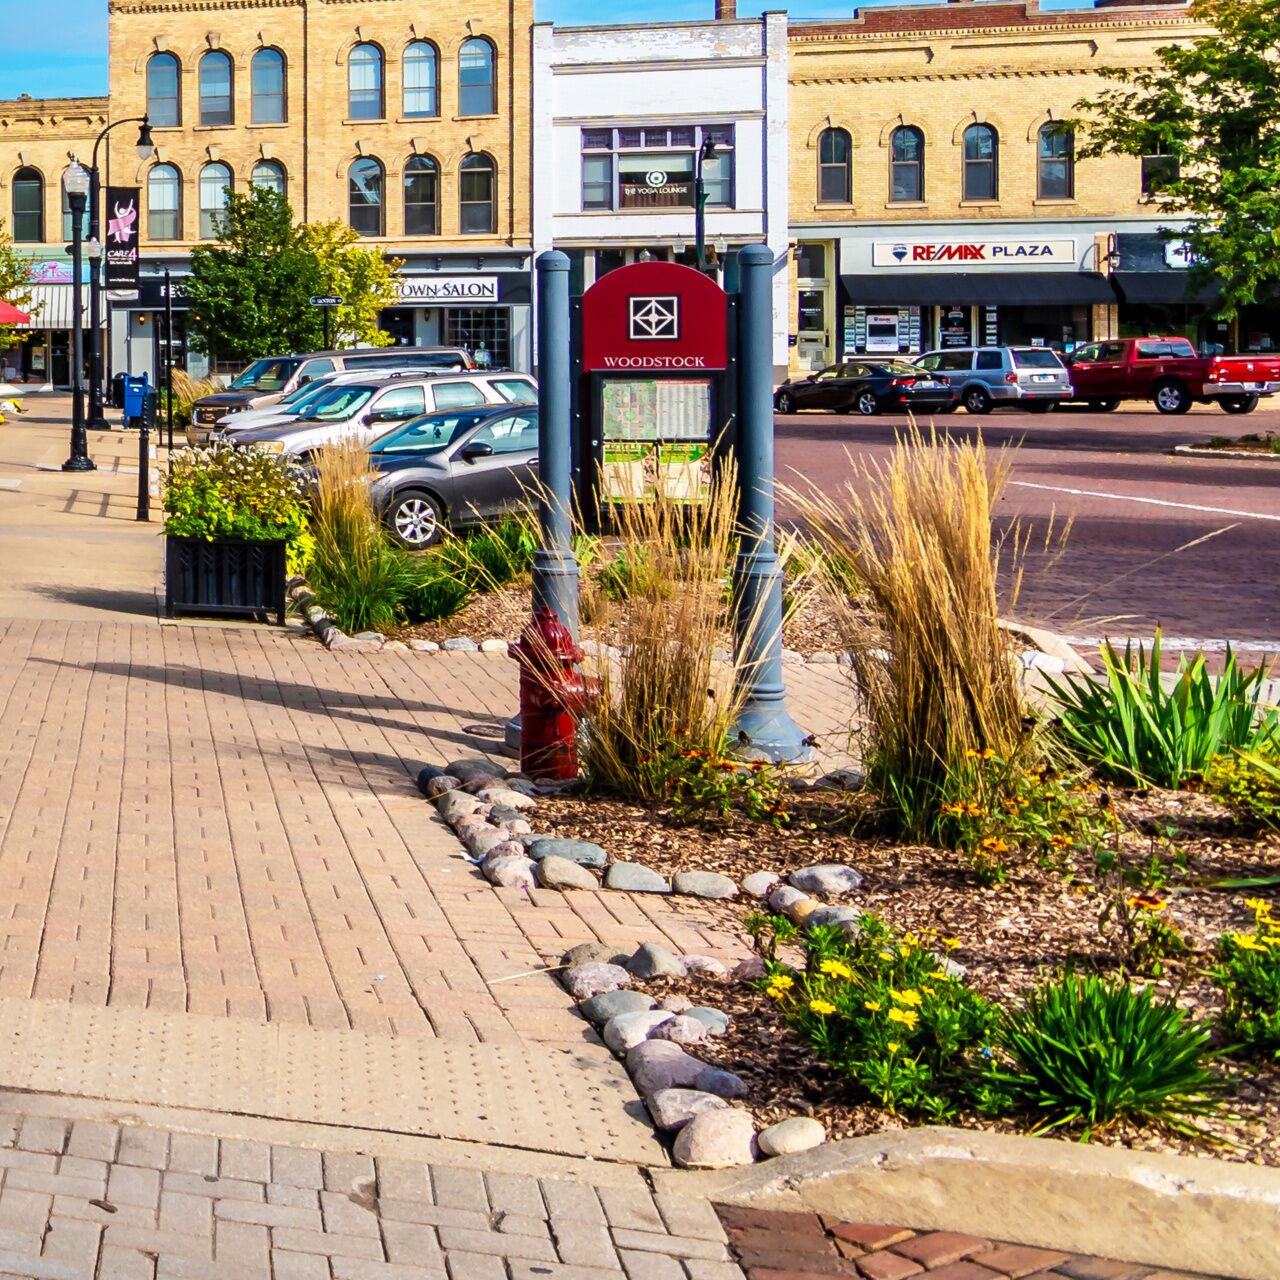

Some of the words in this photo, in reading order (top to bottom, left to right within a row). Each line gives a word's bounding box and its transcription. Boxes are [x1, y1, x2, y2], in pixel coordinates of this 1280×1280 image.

[638, 187, 658, 195] YOGA
[659, 186, 689, 194] LOUNGE
[912, 244, 987, 261] RE/MAX
[992, 245, 1054, 257] PLAZA
[442, 282, 495, 296] SALON
[604, 356, 706, 368] WOODSTOCK
